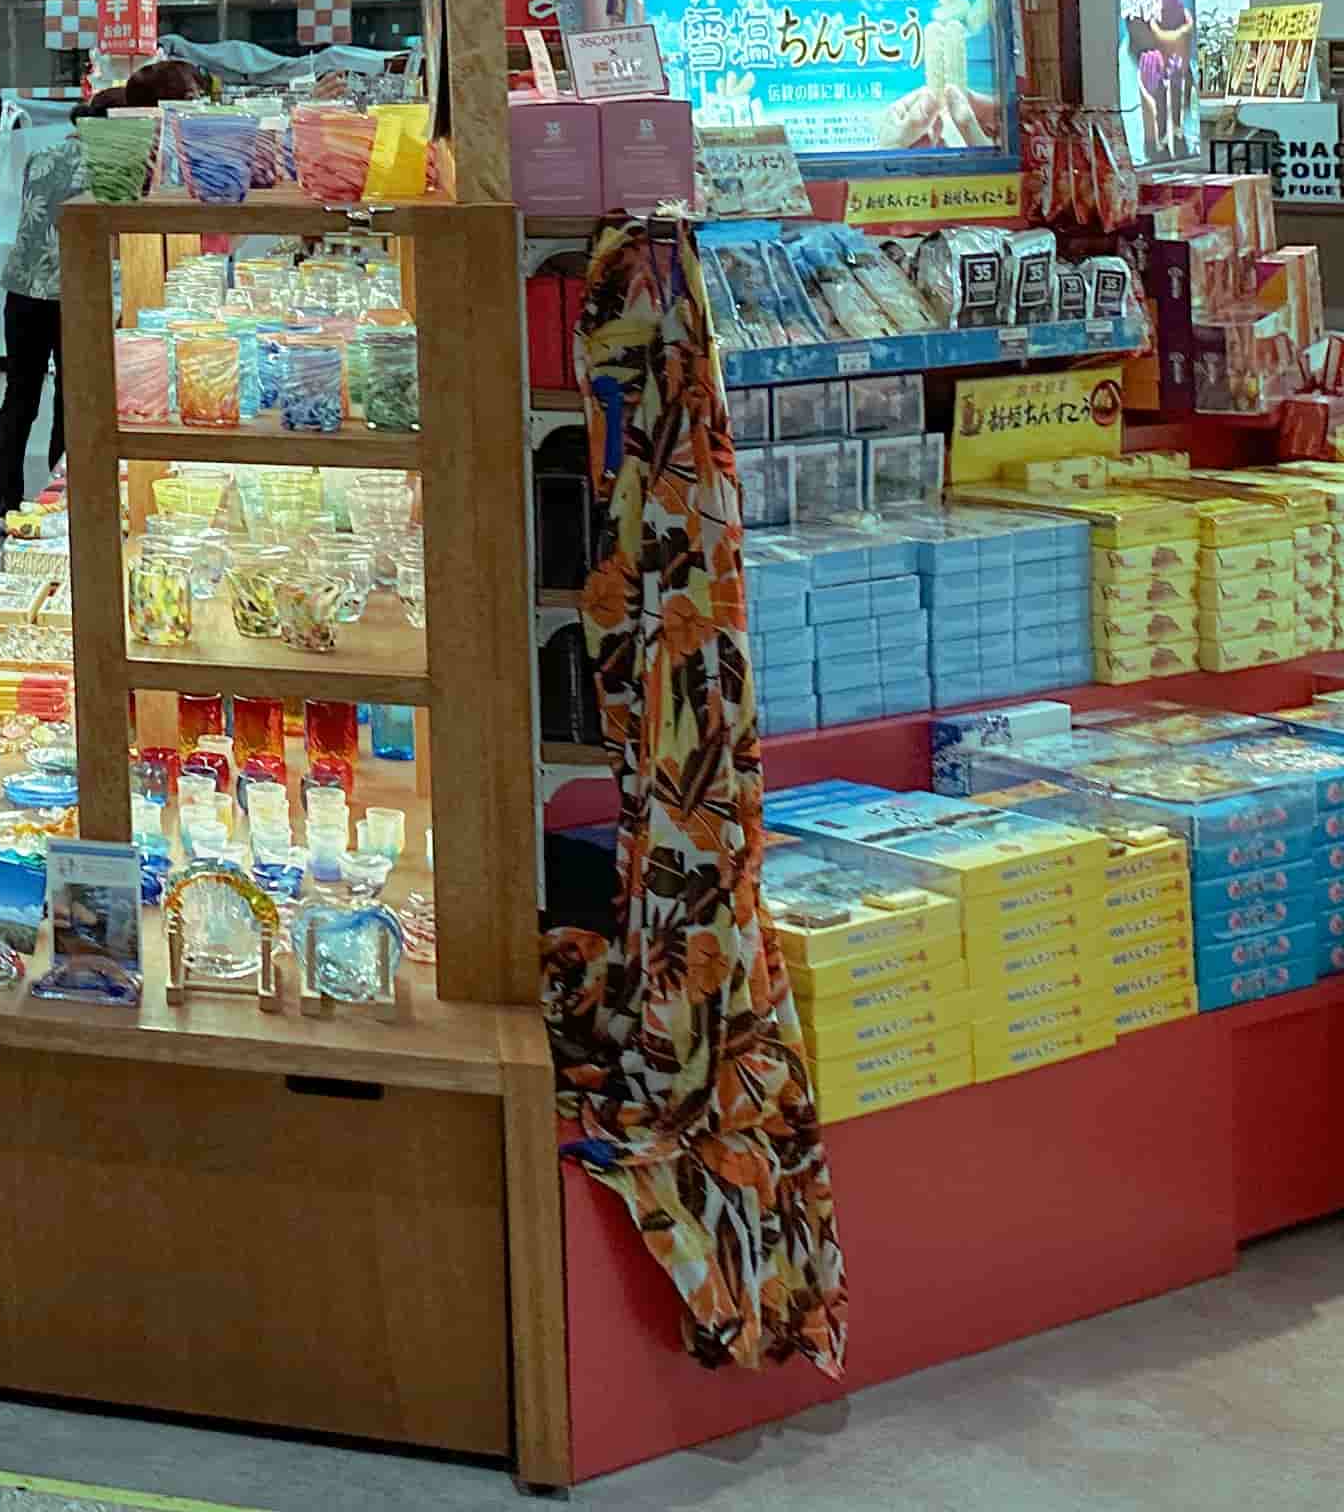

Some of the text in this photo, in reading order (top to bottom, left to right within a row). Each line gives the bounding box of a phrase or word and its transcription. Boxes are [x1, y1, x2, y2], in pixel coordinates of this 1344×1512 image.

[680, 8, 924, 72] 雪塩ちんすこう
[1289, 184, 1344, 196] FUGE
[974, 264, 991, 281] 35
[1029, 264, 1043, 281] 35
